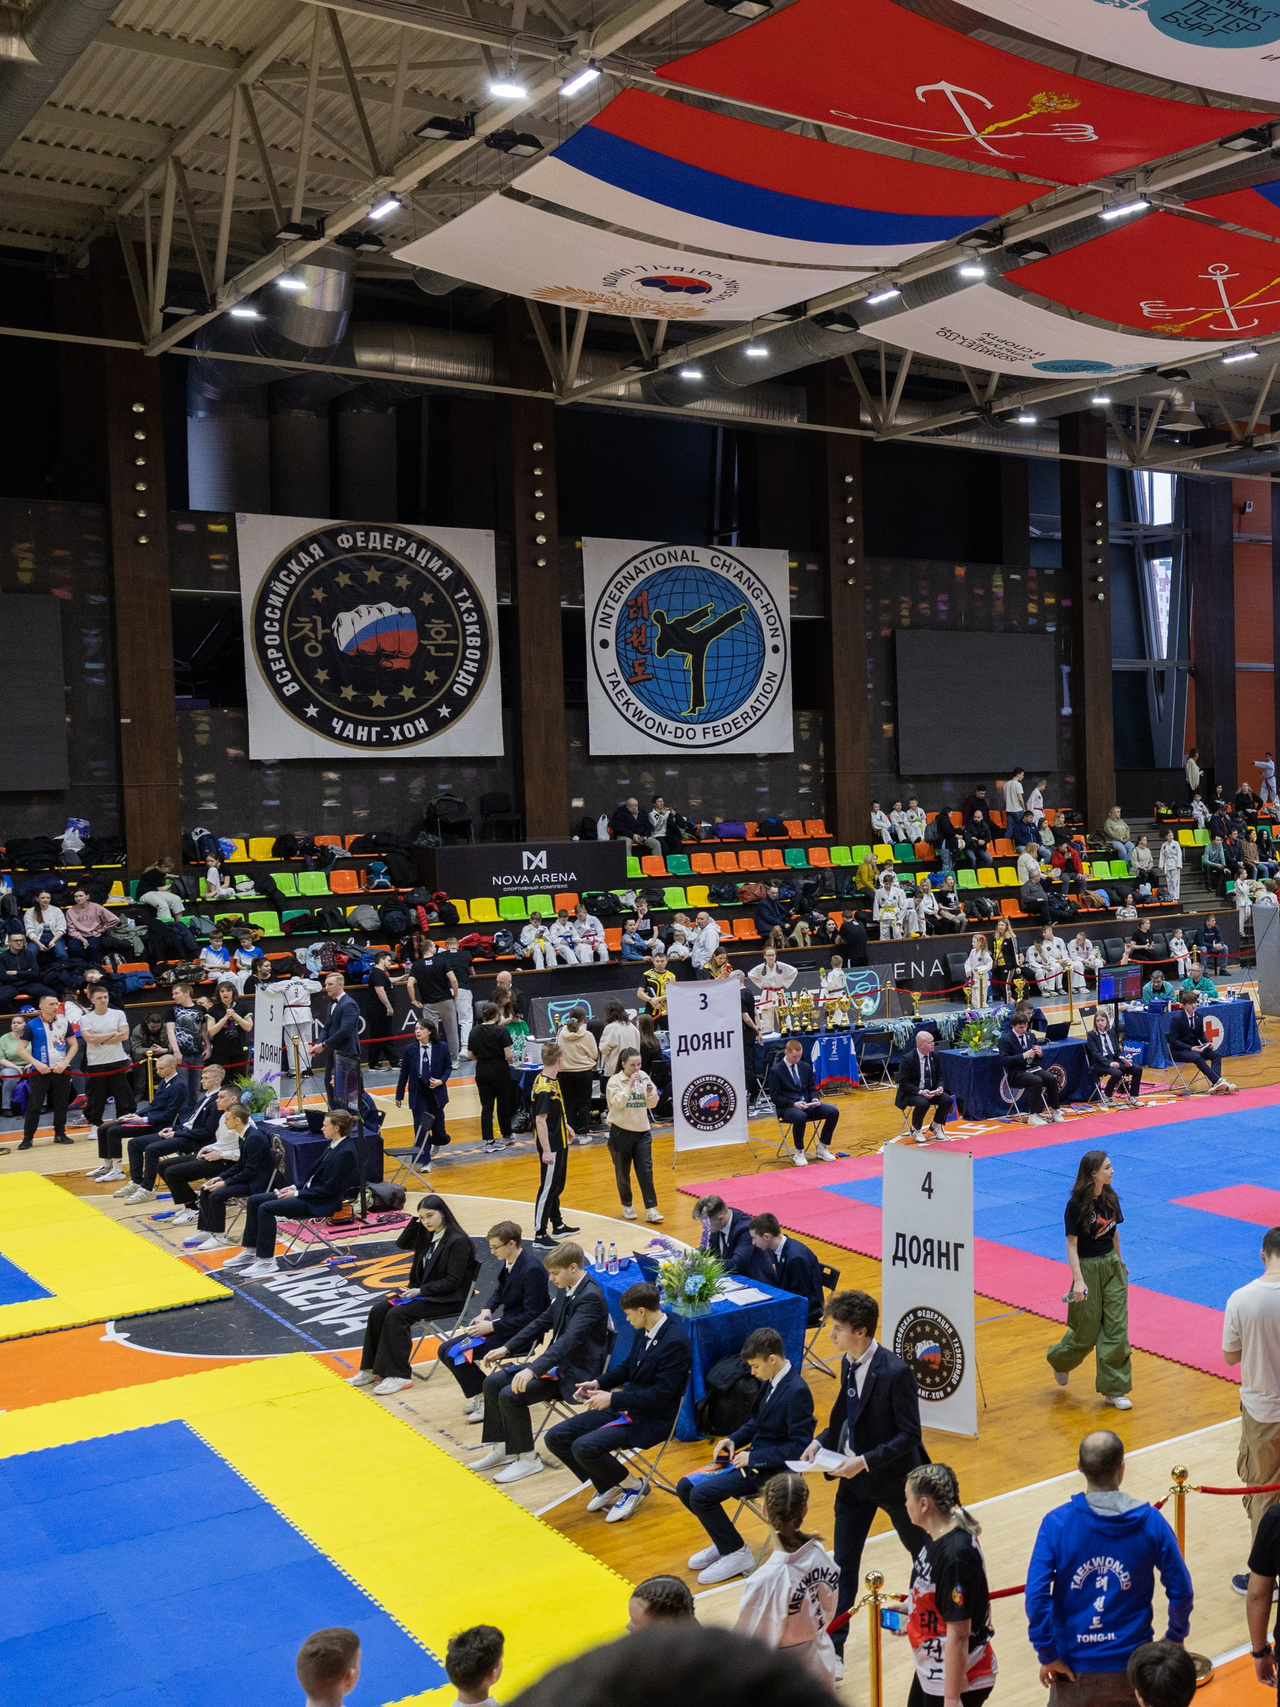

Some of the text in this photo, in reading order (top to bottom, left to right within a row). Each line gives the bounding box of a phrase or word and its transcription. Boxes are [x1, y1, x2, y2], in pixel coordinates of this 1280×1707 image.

[1160, 11, 1230, 37] БУРГ
[601, 549, 782, 640] INTERNATIONAL CH'ANG-HON
[263, 530, 482, 698] ВСЕРОССИЙСКАЯ ФЕДЕРАЦИЯ ТХЭКВОНДО
[290, 615, 330, 658] 창
[604, 667, 778, 740] TAEKWON-DO FEDERATION
[330, 715, 430, 742] ЧАНГ-ХОН
[492, 872, 577, 886] NOVA ARENA
[894, 958, 945, 980] ENA
[269, 1004, 274, 1022] 5
[699, 993, 708, 1010] 3
[677, 1030, 735, 1057] ДОЯНГ
[921, 1171, 934, 1200] 4
[892, 1231, 965, 1272] ДОЯНГ
[895, 1309, 963, 1385] ОССИЙСКАЯ ФЕДЕРАЦИЯ ТХЭКВОНДО
[917, 1388, 945, 1400] АНГ-ХОН
[1070, 1555, 1132, 1591] TAEKWON-DO
[1076, 1632, 1118, 1644] TONG-IL
